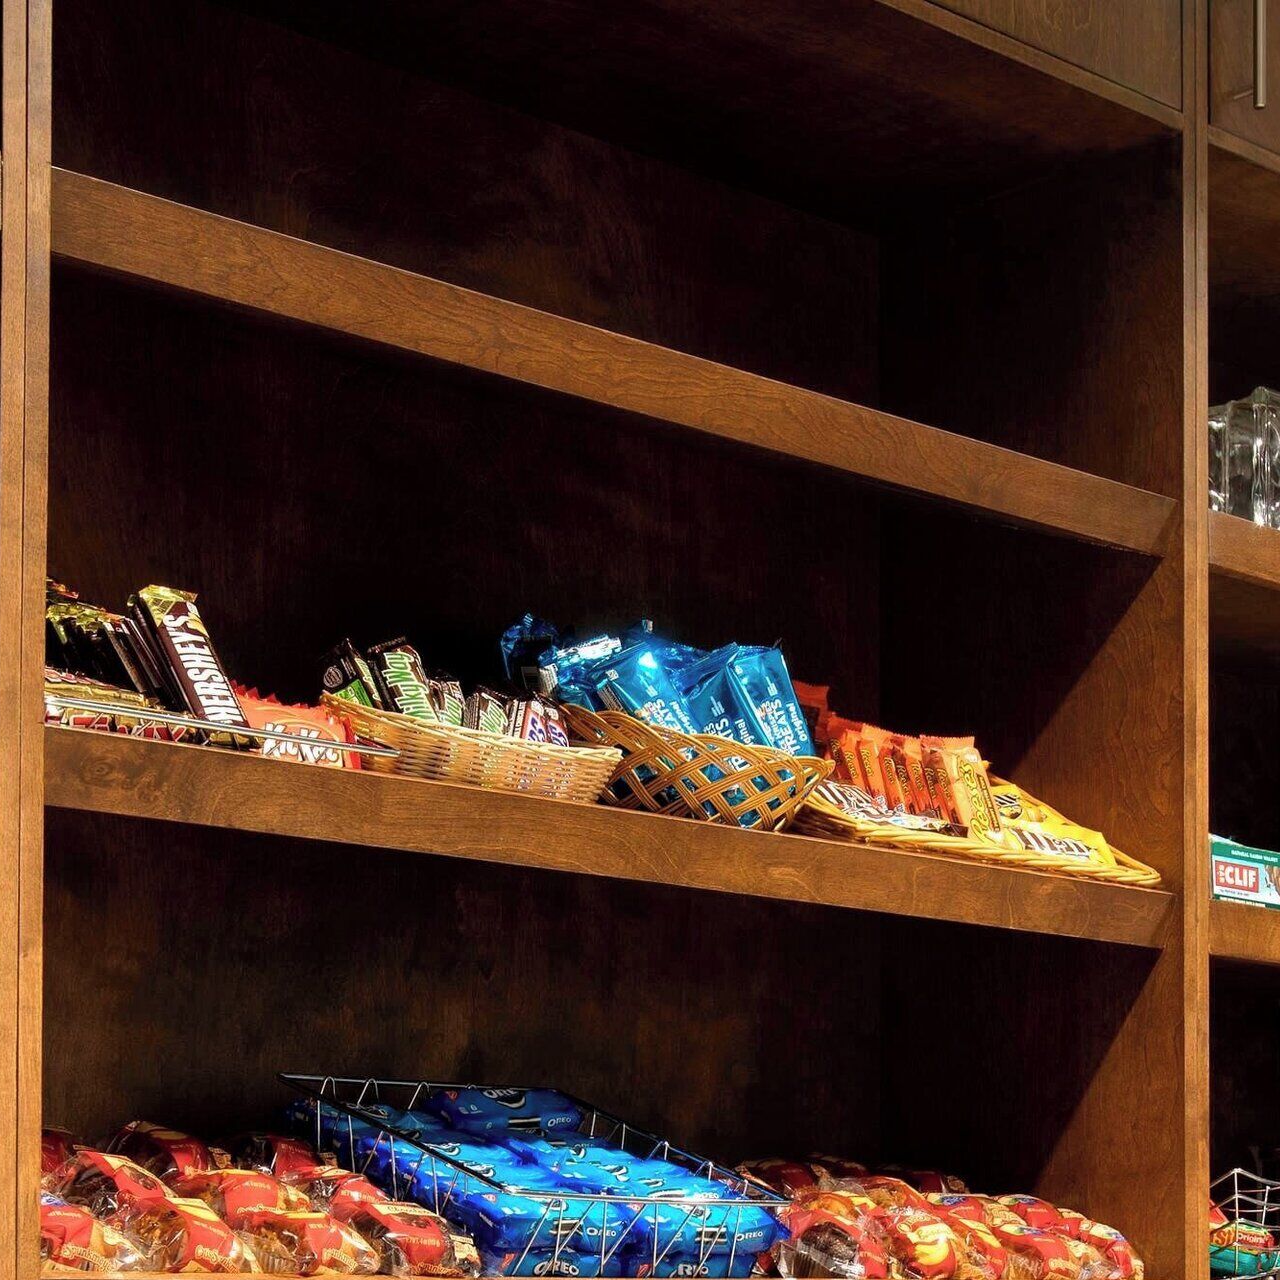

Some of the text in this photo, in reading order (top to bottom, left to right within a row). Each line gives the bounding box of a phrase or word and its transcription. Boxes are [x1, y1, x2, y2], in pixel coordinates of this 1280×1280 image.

[162, 614, 245, 726] HERSHEY'S
[772, 698, 801, 756] TREATS
[959, 760, 992, 844] Reese's
[1224, 866, 1257, 889] CLIF
[547, 1115, 572, 1128] OREO
[735, 1231, 764, 1242] OREO
[533, 1259, 580, 1277] OREO
